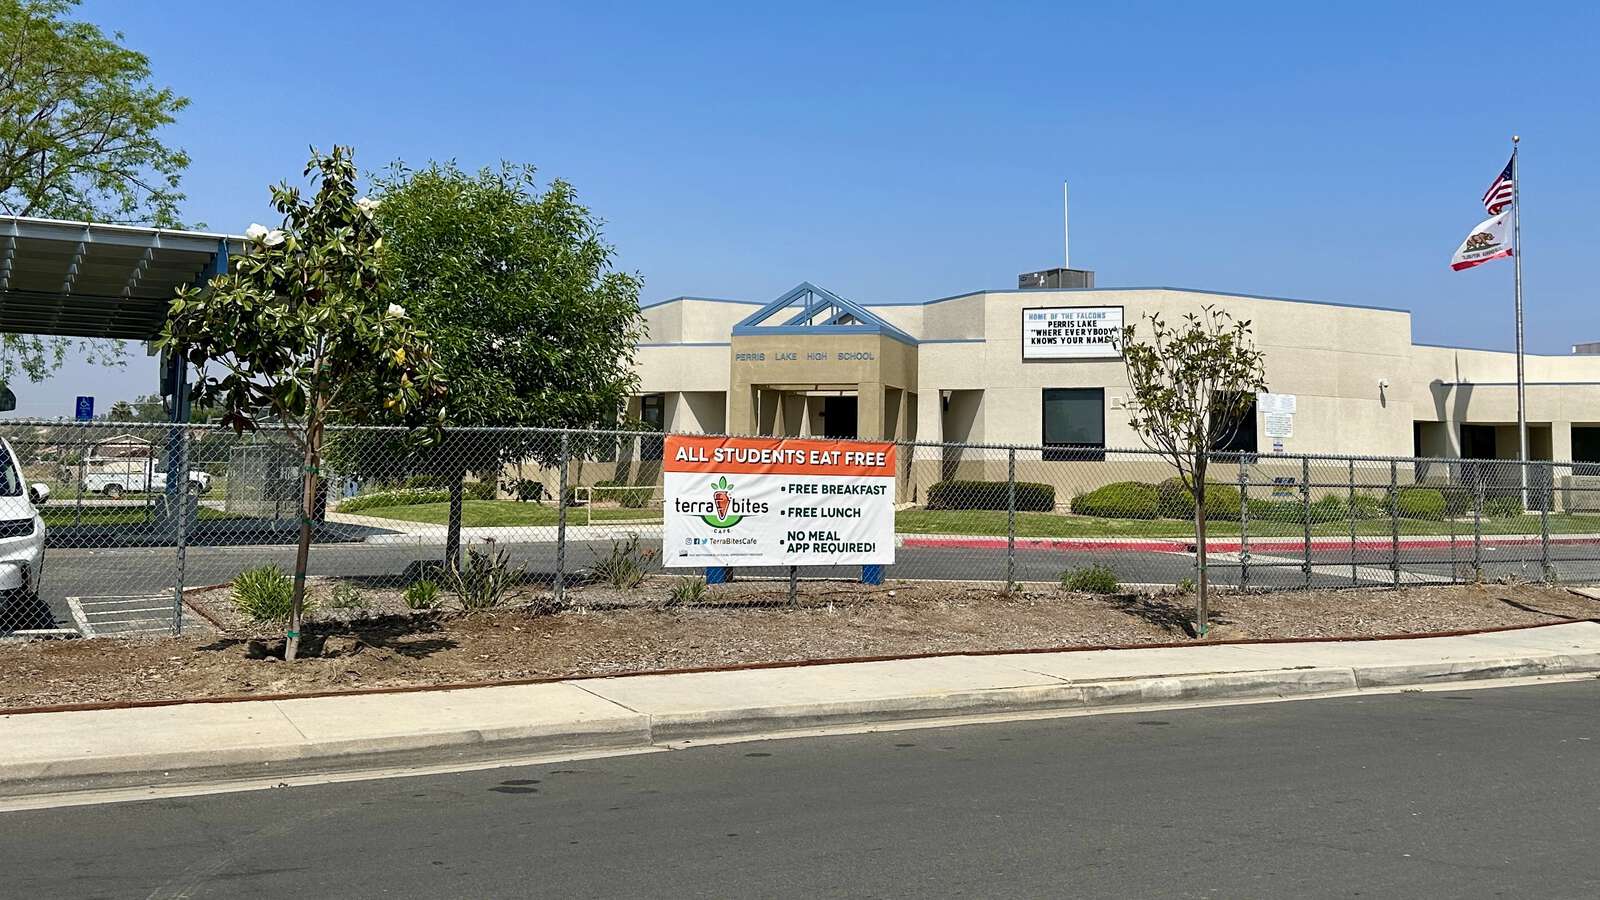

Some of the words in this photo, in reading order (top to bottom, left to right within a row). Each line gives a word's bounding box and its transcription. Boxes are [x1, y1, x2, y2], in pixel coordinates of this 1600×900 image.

[736, 352, 766, 361] PERRIS
[775, 352, 797, 360] LAKE
[806, 352, 828, 360] HIGH
[838, 352, 874, 360] SCHOOL
[675, 446, 709, 462] ALL
[713, 447, 806, 464] STUDENTS
[810, 450, 842, 466] EAT
[845, 452, 886, 466] FREE
[788, 484, 818, 494] FREE
[822, 484, 887, 495] BREAKFAST
[675, 498, 714, 512] terra
[732, 498, 769, 513] bites
[788, 508, 818, 518] FREE
[821, 508, 861, 518] LUNCH
[787, 531, 806, 541] NO
[808, 531, 840, 541] MEAL
[786, 543, 810, 553] APP
[813, 543, 876, 554] REQUIRED!
